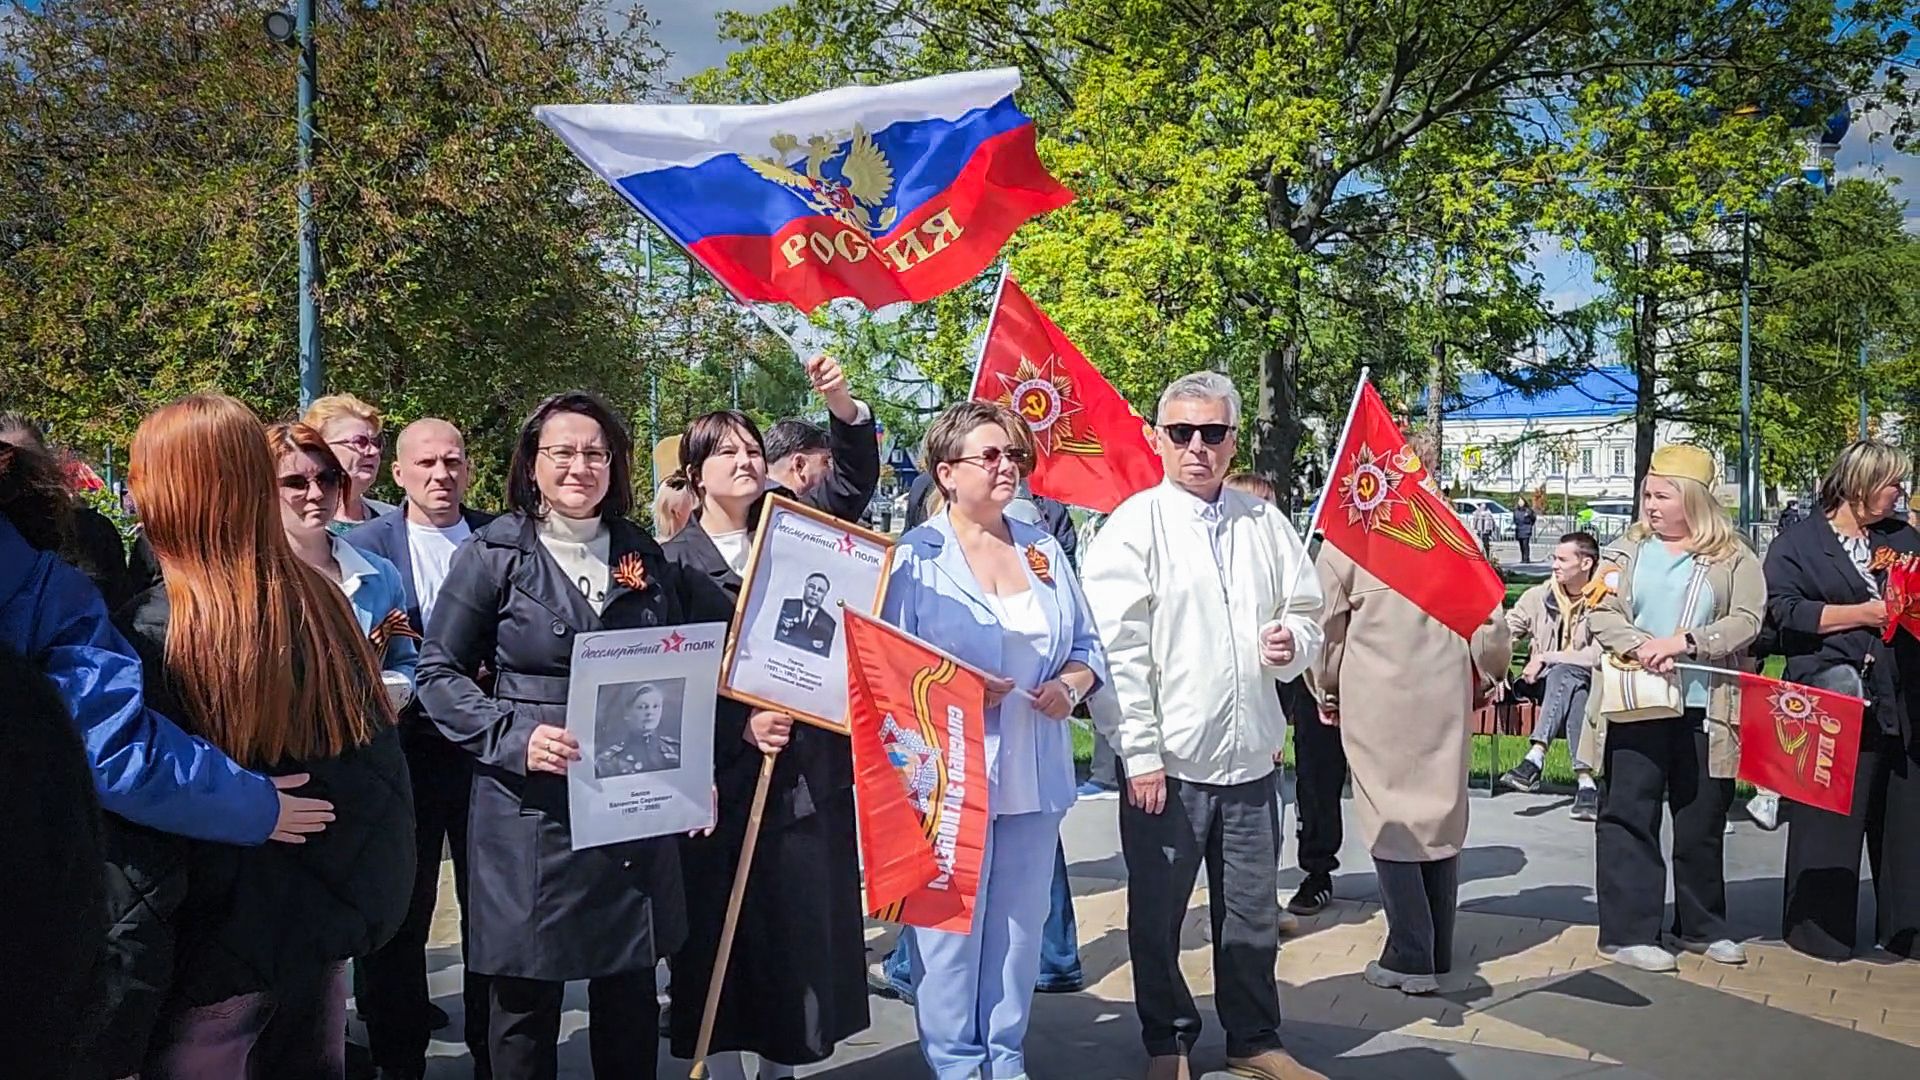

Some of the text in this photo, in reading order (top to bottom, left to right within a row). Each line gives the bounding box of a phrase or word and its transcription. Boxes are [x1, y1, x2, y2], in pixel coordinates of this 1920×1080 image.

[780, 206, 965, 273] РОСИЯ
[1814, 715, 1841, 788] 9 МАЯ
